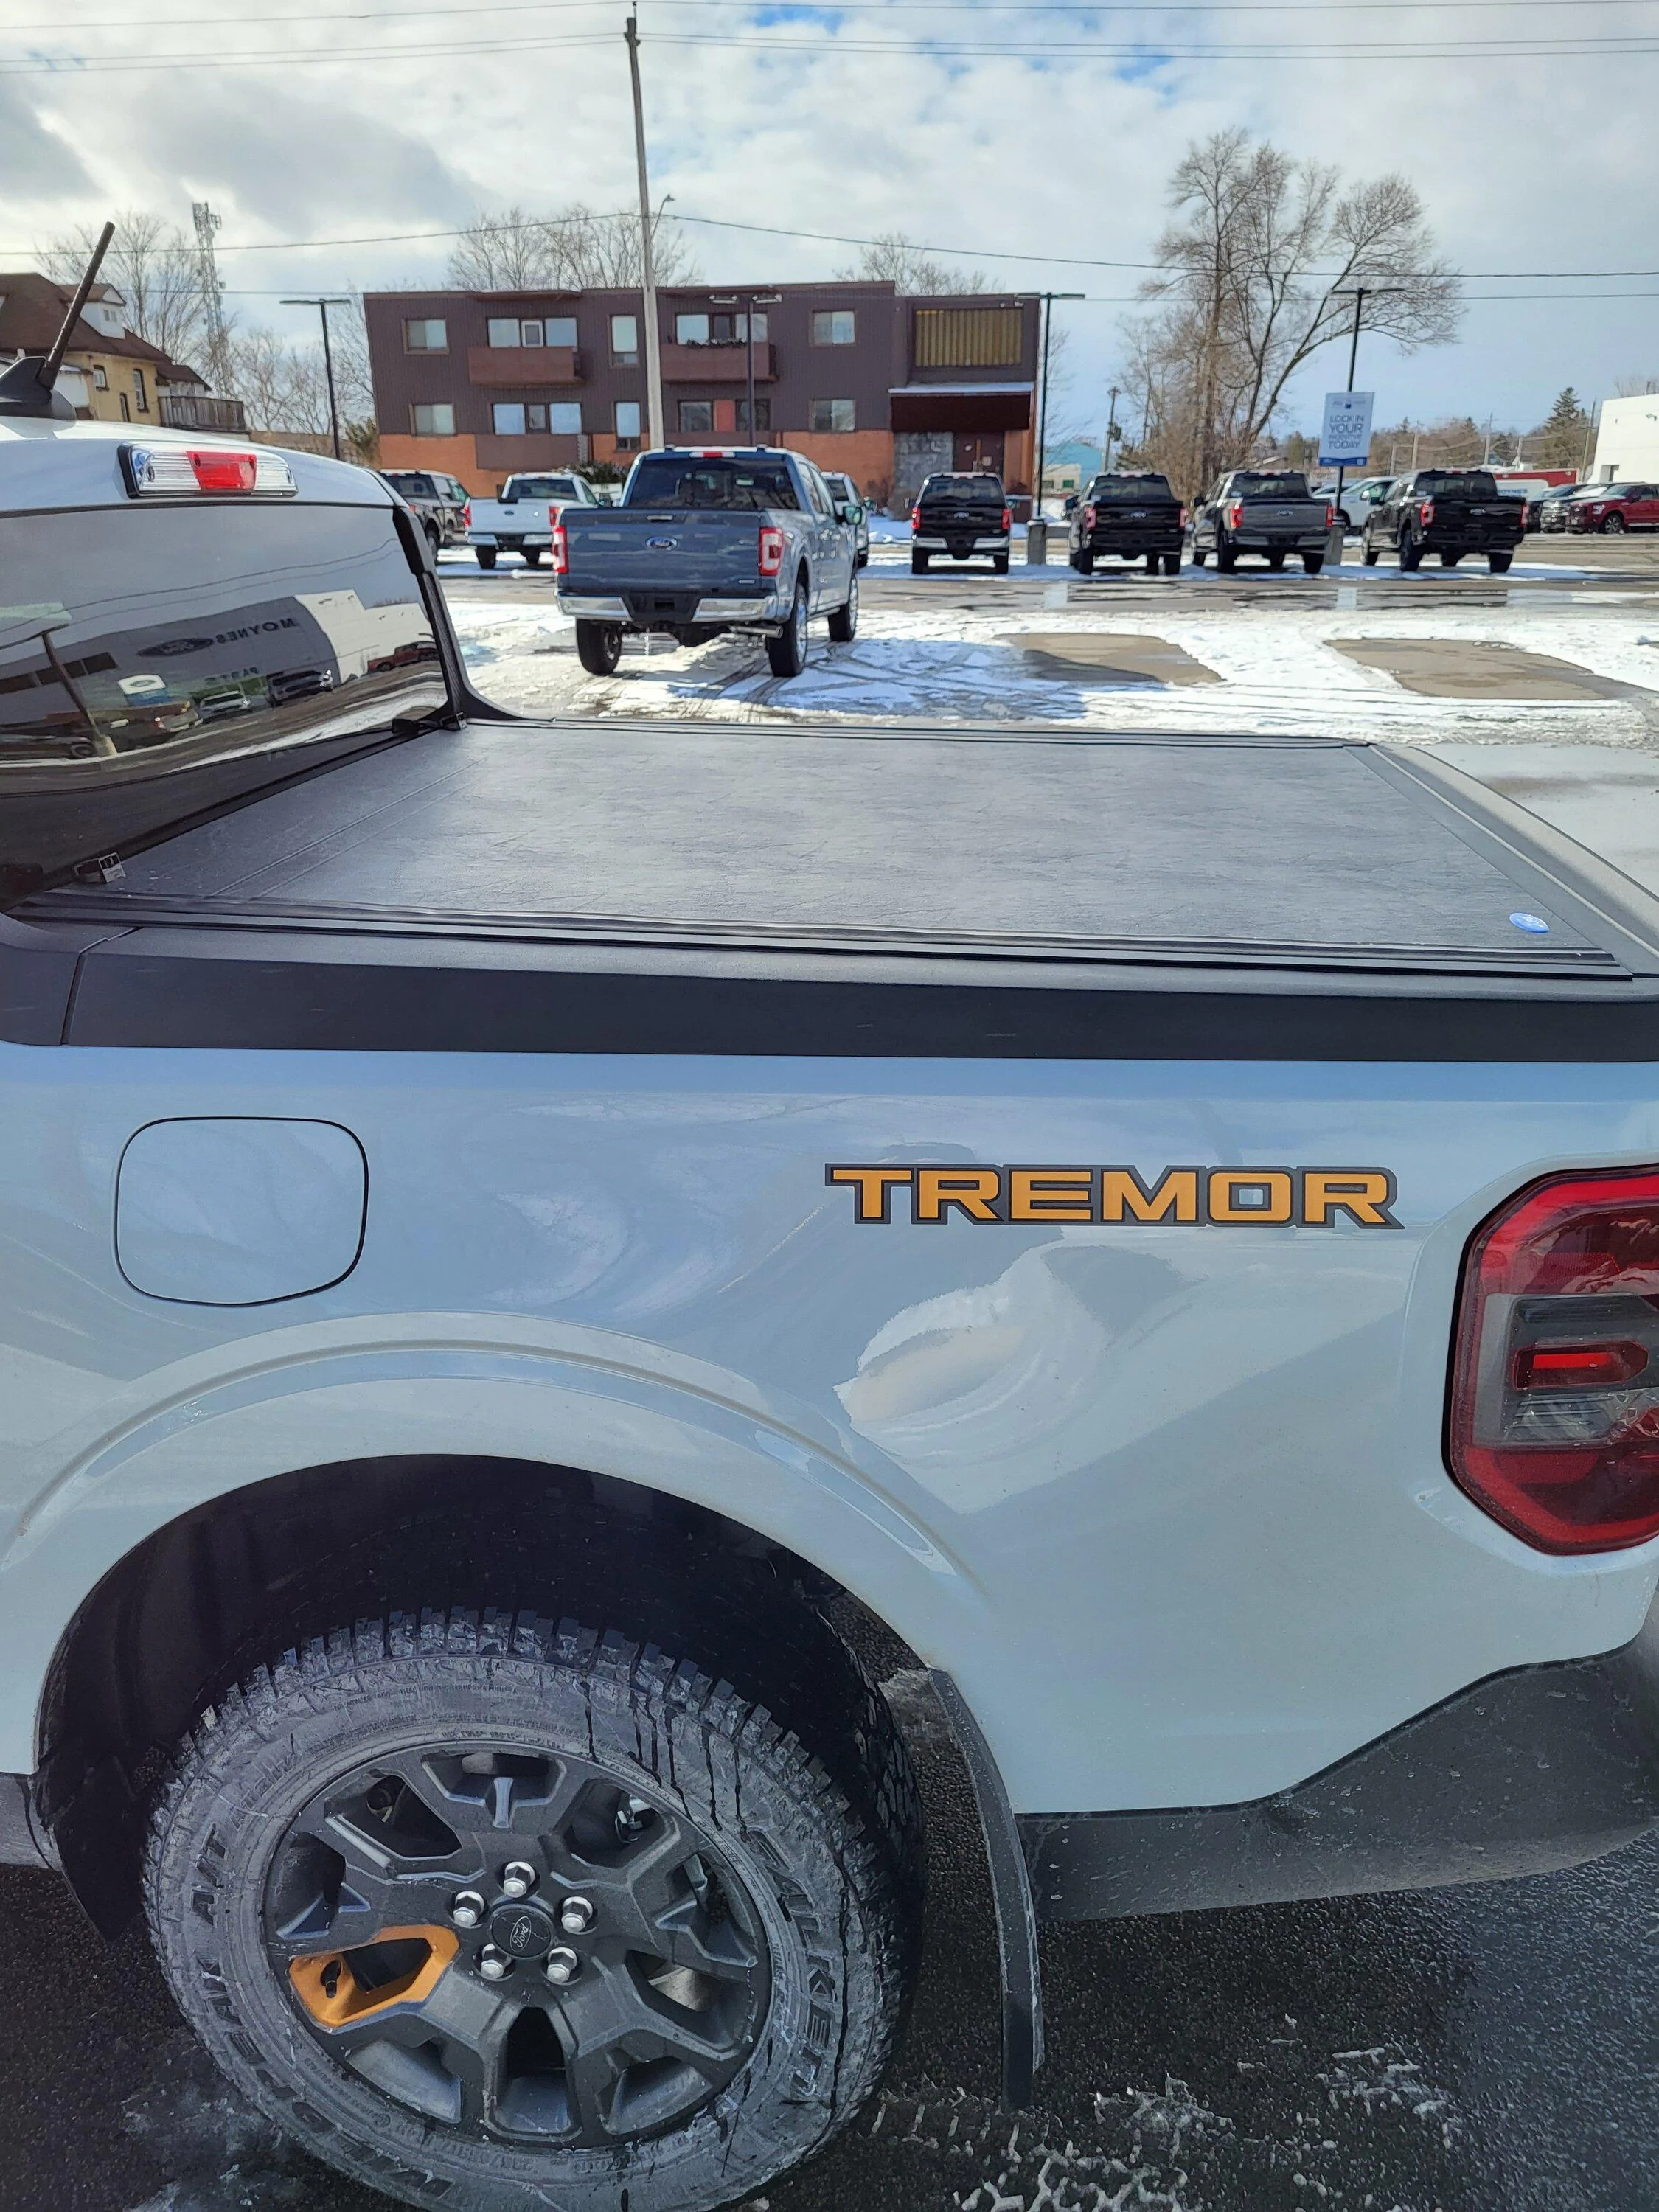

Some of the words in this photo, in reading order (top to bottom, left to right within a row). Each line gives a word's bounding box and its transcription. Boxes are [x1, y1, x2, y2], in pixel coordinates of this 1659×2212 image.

[1329, 414, 1353, 423] LOCK
[1354, 414, 1364, 422] IN
[1329, 422, 1363, 434] YOUR
[1329, 441, 1362, 449] TODAY
[825, 1163, 1405, 1229] TREMOR
[192, 1824, 229, 1925] A/T
[512, 1922, 529, 1948] Ford
